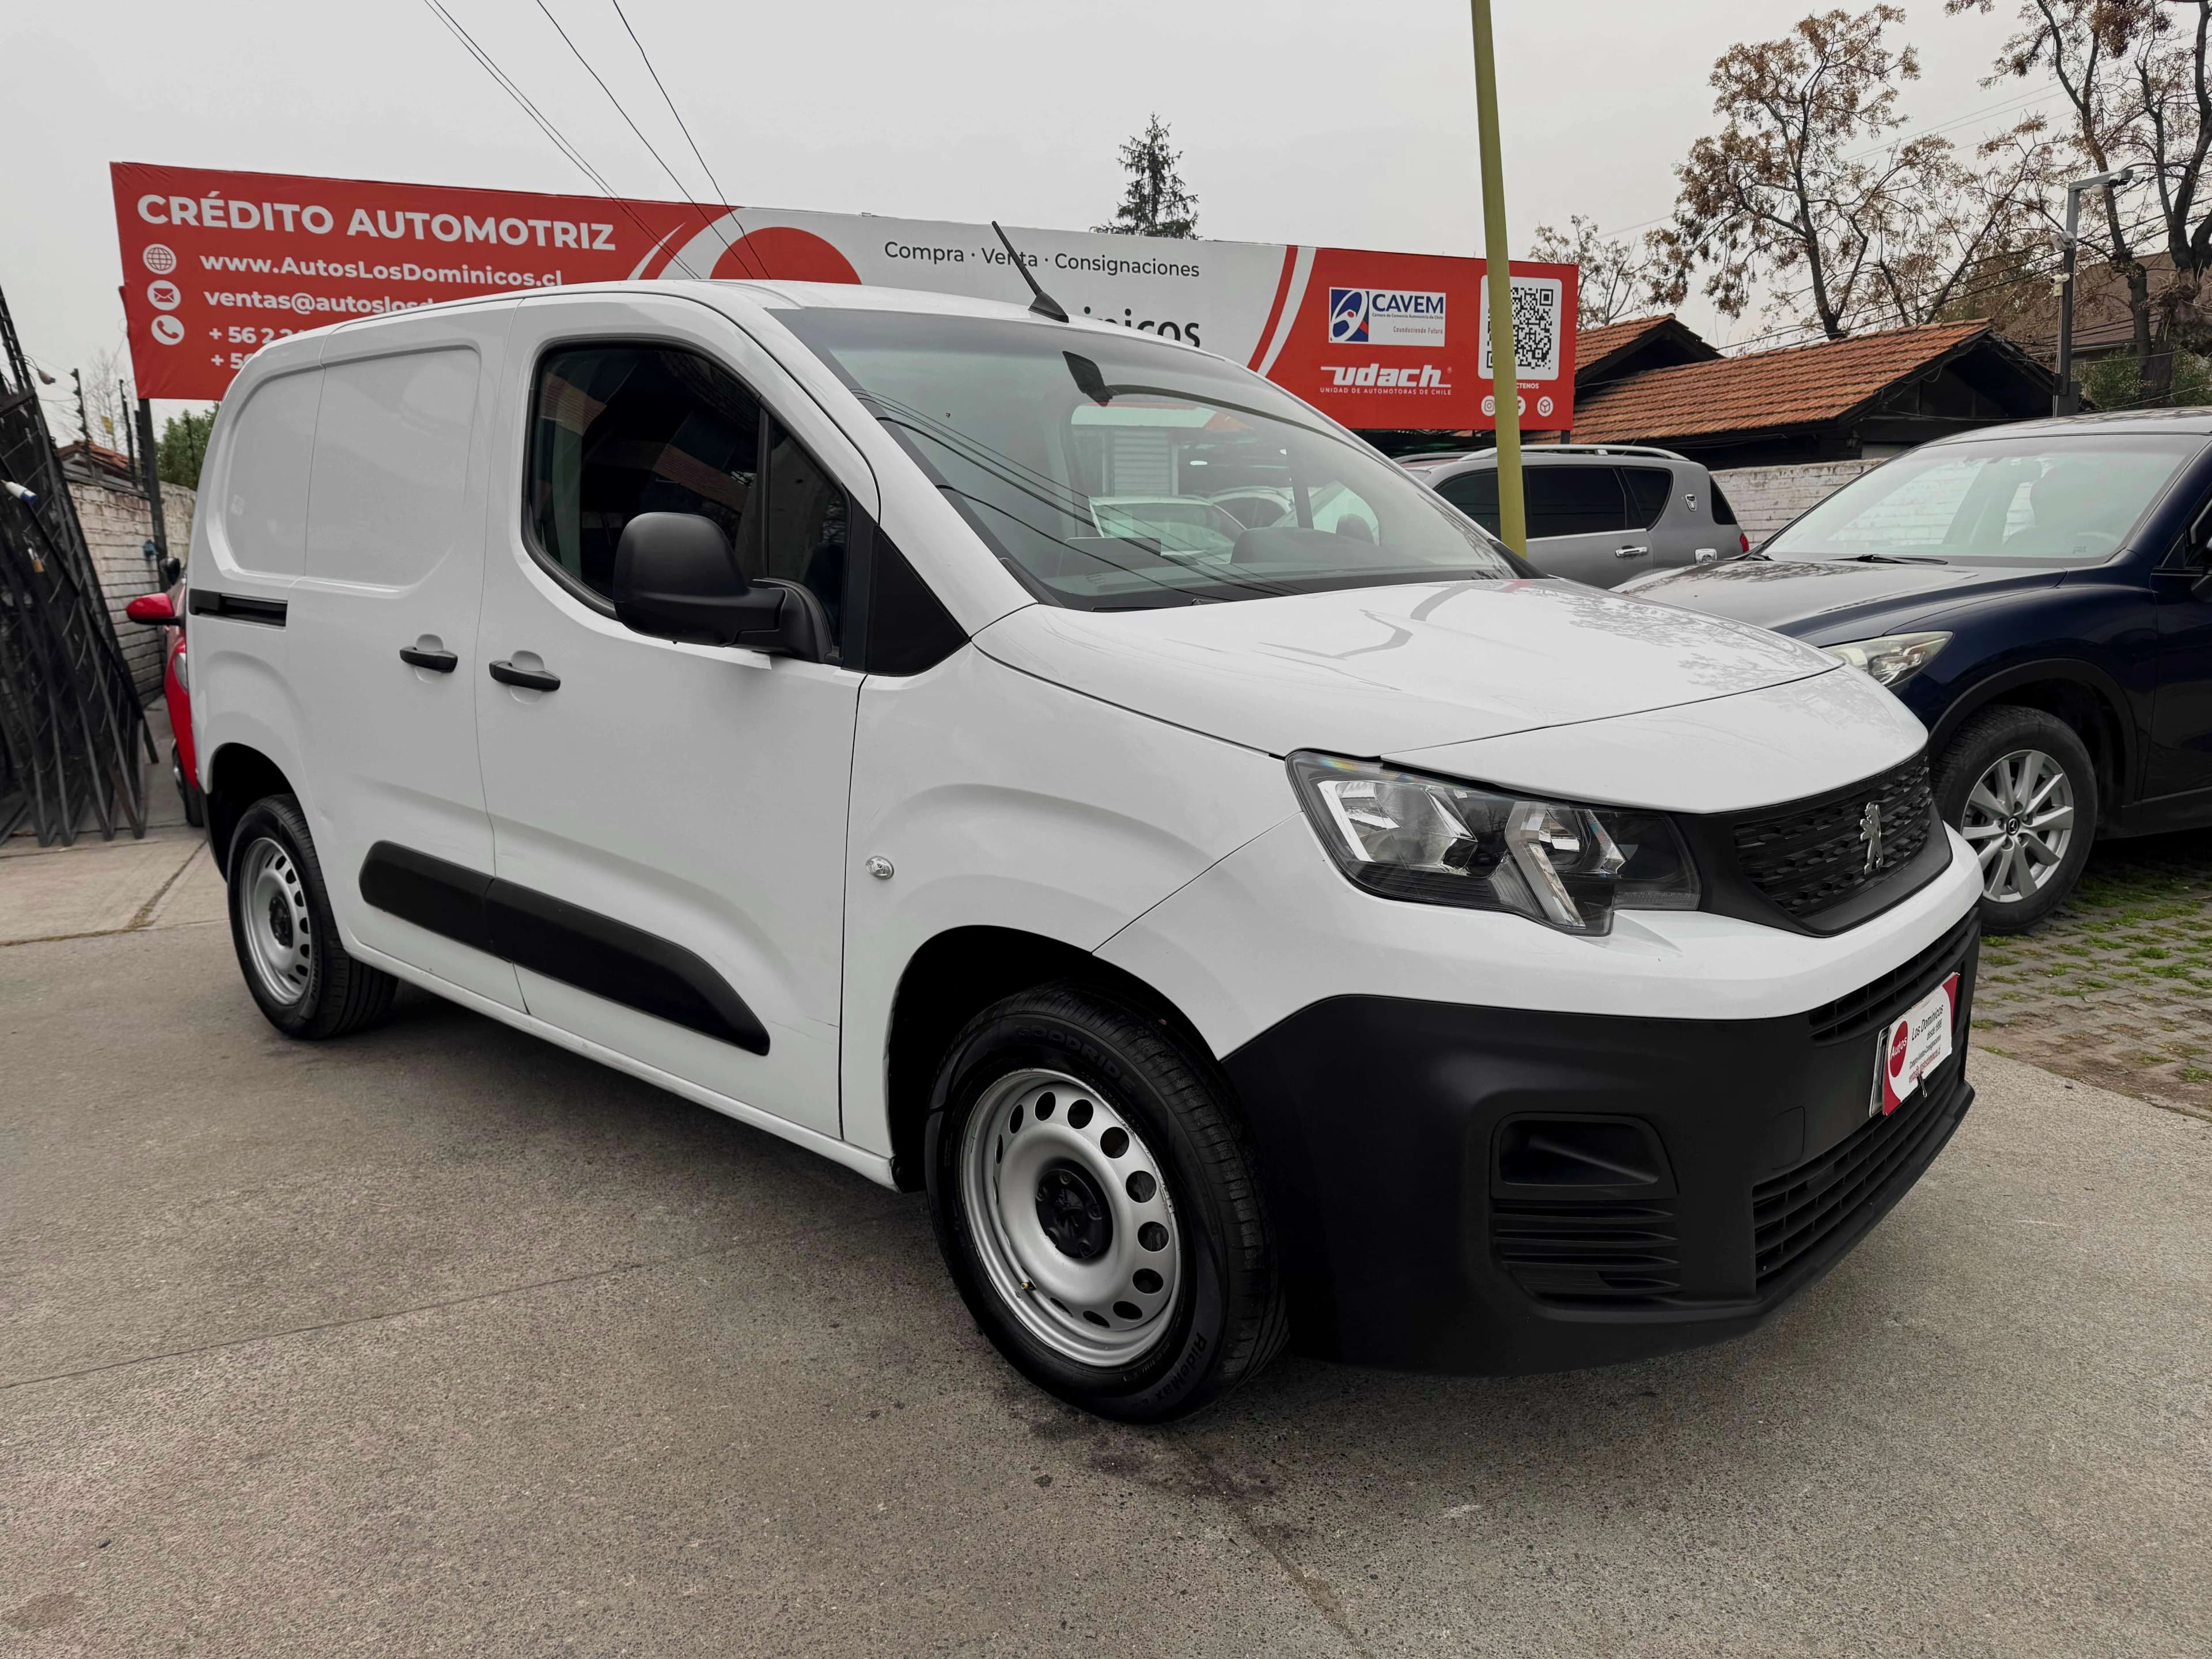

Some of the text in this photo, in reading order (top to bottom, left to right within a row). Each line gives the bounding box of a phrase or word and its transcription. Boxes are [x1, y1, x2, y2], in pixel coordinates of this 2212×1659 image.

[137, 191, 616, 251] CRÉDITO AUTOMOTRIZ
[199, 254, 562, 287] www.AutosLosDominicos.cl
[884, 241, 964, 264] Compra
[1055, 253, 1200, 277] Consignaciones
[1372, 293, 1444, 314] CAVEM
[228, 325, 257, 344] 56
[1320, 363, 1452, 388] udach
[1911, 1006, 1944, 1041] Los Dominicos
[1890, 1036, 1908, 1060] Autos
[1155, 1331, 1207, 1401] RideMax
